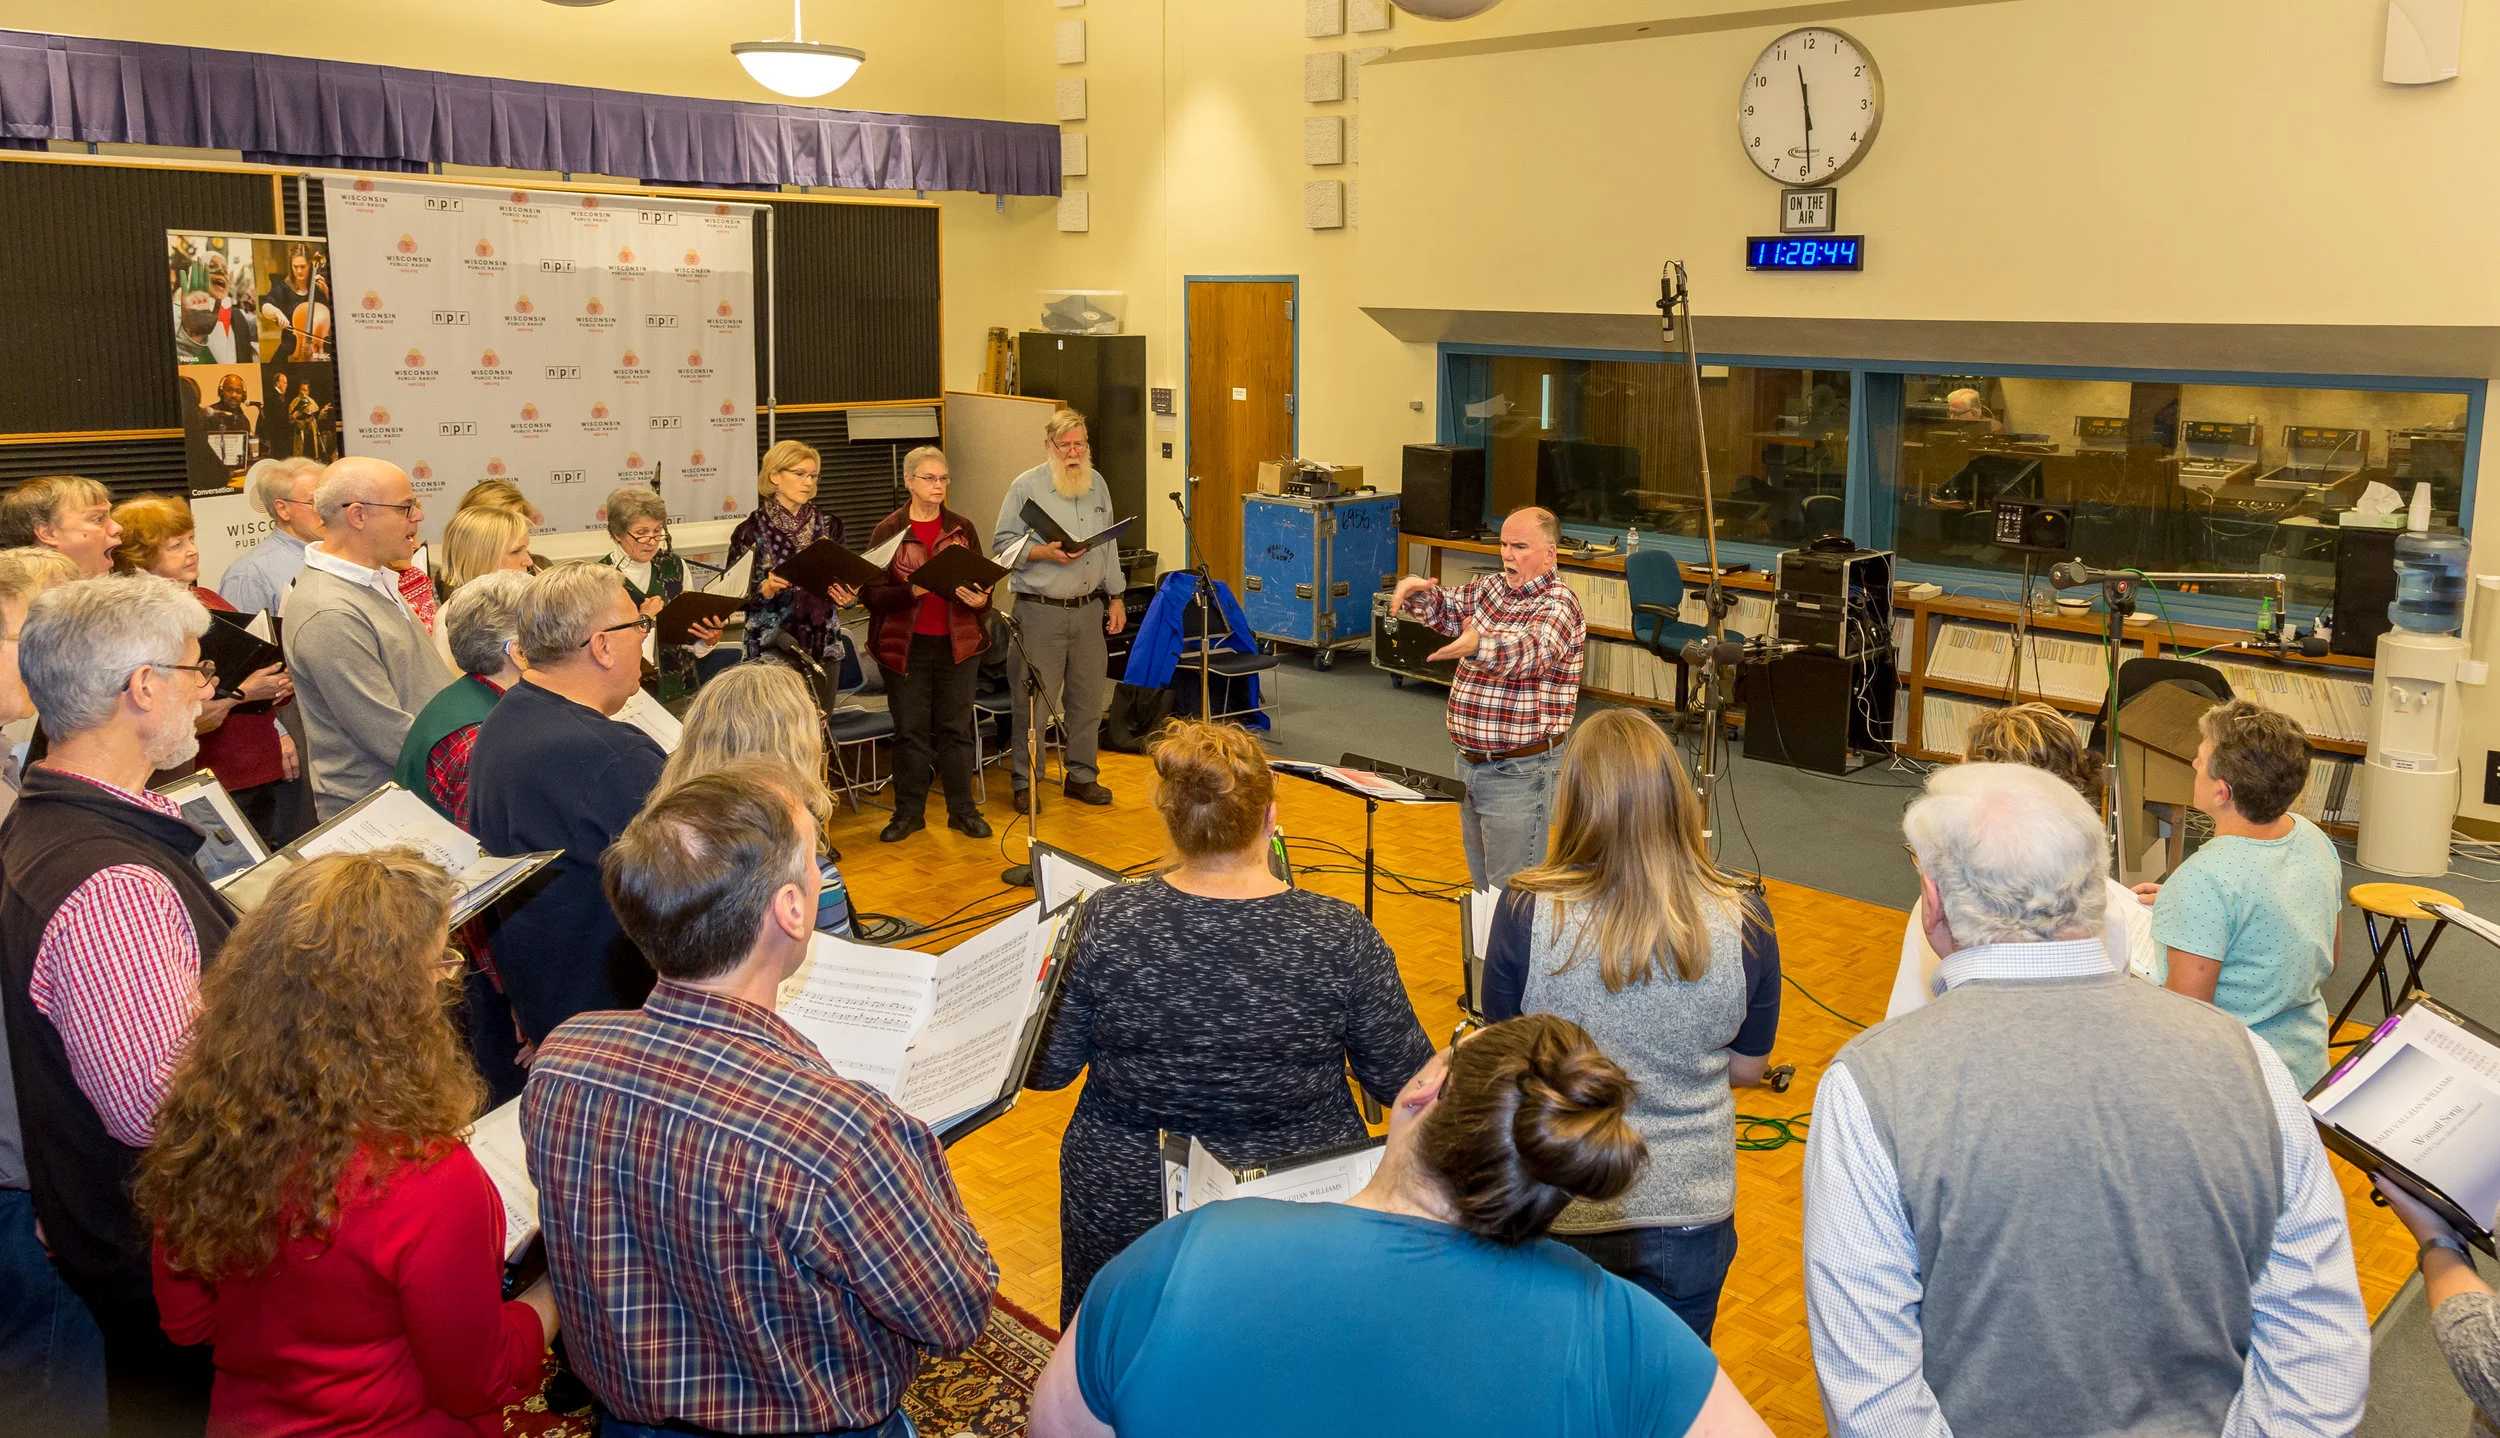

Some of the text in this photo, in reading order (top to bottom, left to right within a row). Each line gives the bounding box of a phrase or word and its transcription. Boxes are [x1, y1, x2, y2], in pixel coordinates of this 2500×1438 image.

[1804, 39, 1815, 49] 12
[1834, 44, 1838, 54] 1
[1777, 50, 1786, 60] 11
[1854, 67, 1861, 77] 2
[1755, 77, 1767, 87] 10
[1861, 100, 1867, 109] 3
[1748, 106, 1754, 116] 9
[1754, 137, 1760, 147] 8
[1850, 132, 1857, 142] 4
[1774, 159, 1780, 169] 7
[1828, 157, 1834, 167] 5
[1800, 166, 1807, 176] 6
[341, 194, 387, 203] WISCONSIN
[1790, 195, 1823, 210] ON THE
[428, 199, 459, 210] npr
[499, 206, 540, 214] WISCONSIN
[641, 211, 673, 224] npr
[1799, 210, 1814, 224] AIR
[1759, 242, 1855, 265] 11:28:44
[543, 262, 572, 272] npr
[434, 312, 465, 323] npr
[648, 317, 675, 326] npr
[180, 355, 199, 363] News
[548, 368, 576, 378] npr
[652, 418, 678, 428] npr
[442, 424, 471, 435] npr
[554, 472, 582, 482] npr
[192, 486, 235, 497] Conversation
[226, 520, 276, 537] WISCO
[2439, 1105, 2464, 1124] Song
[1309, 1184, 1342, 1196] WILLIAMS
